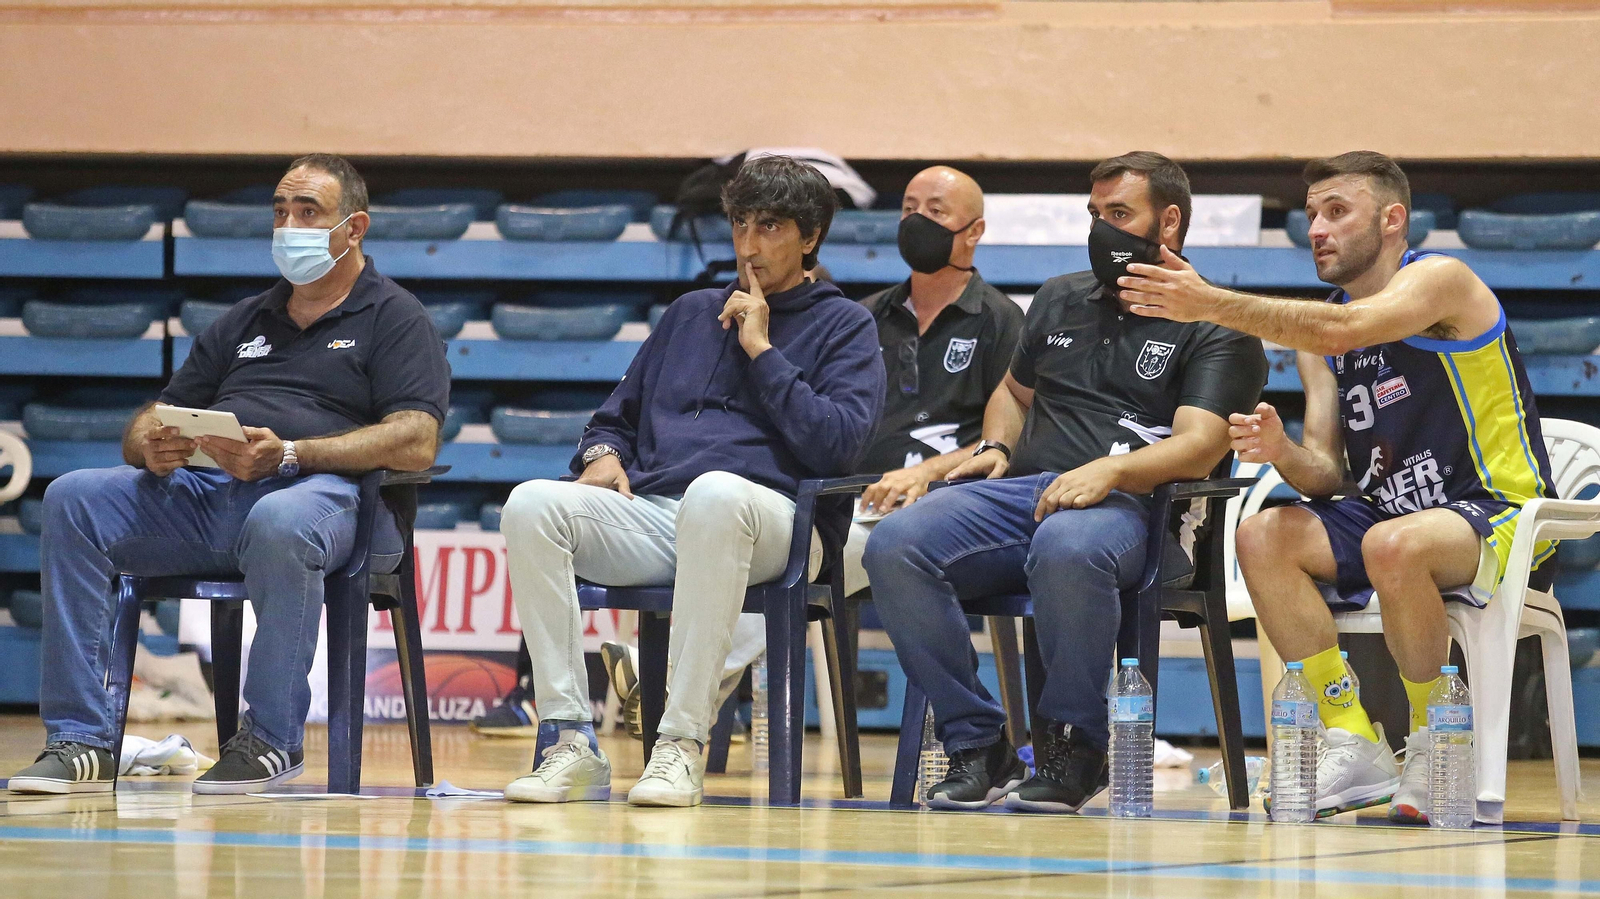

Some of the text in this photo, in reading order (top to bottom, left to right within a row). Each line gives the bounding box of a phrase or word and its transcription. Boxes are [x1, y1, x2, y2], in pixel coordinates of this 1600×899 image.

[1380, 388, 1406, 404] CENTRO
[1403, 449, 1432, 467] VITALIS
[1371, 458, 1443, 502] NER
[363, 696, 486, 721] ANDLUZA
[1437, 716, 1467, 724] ARQUILLO
